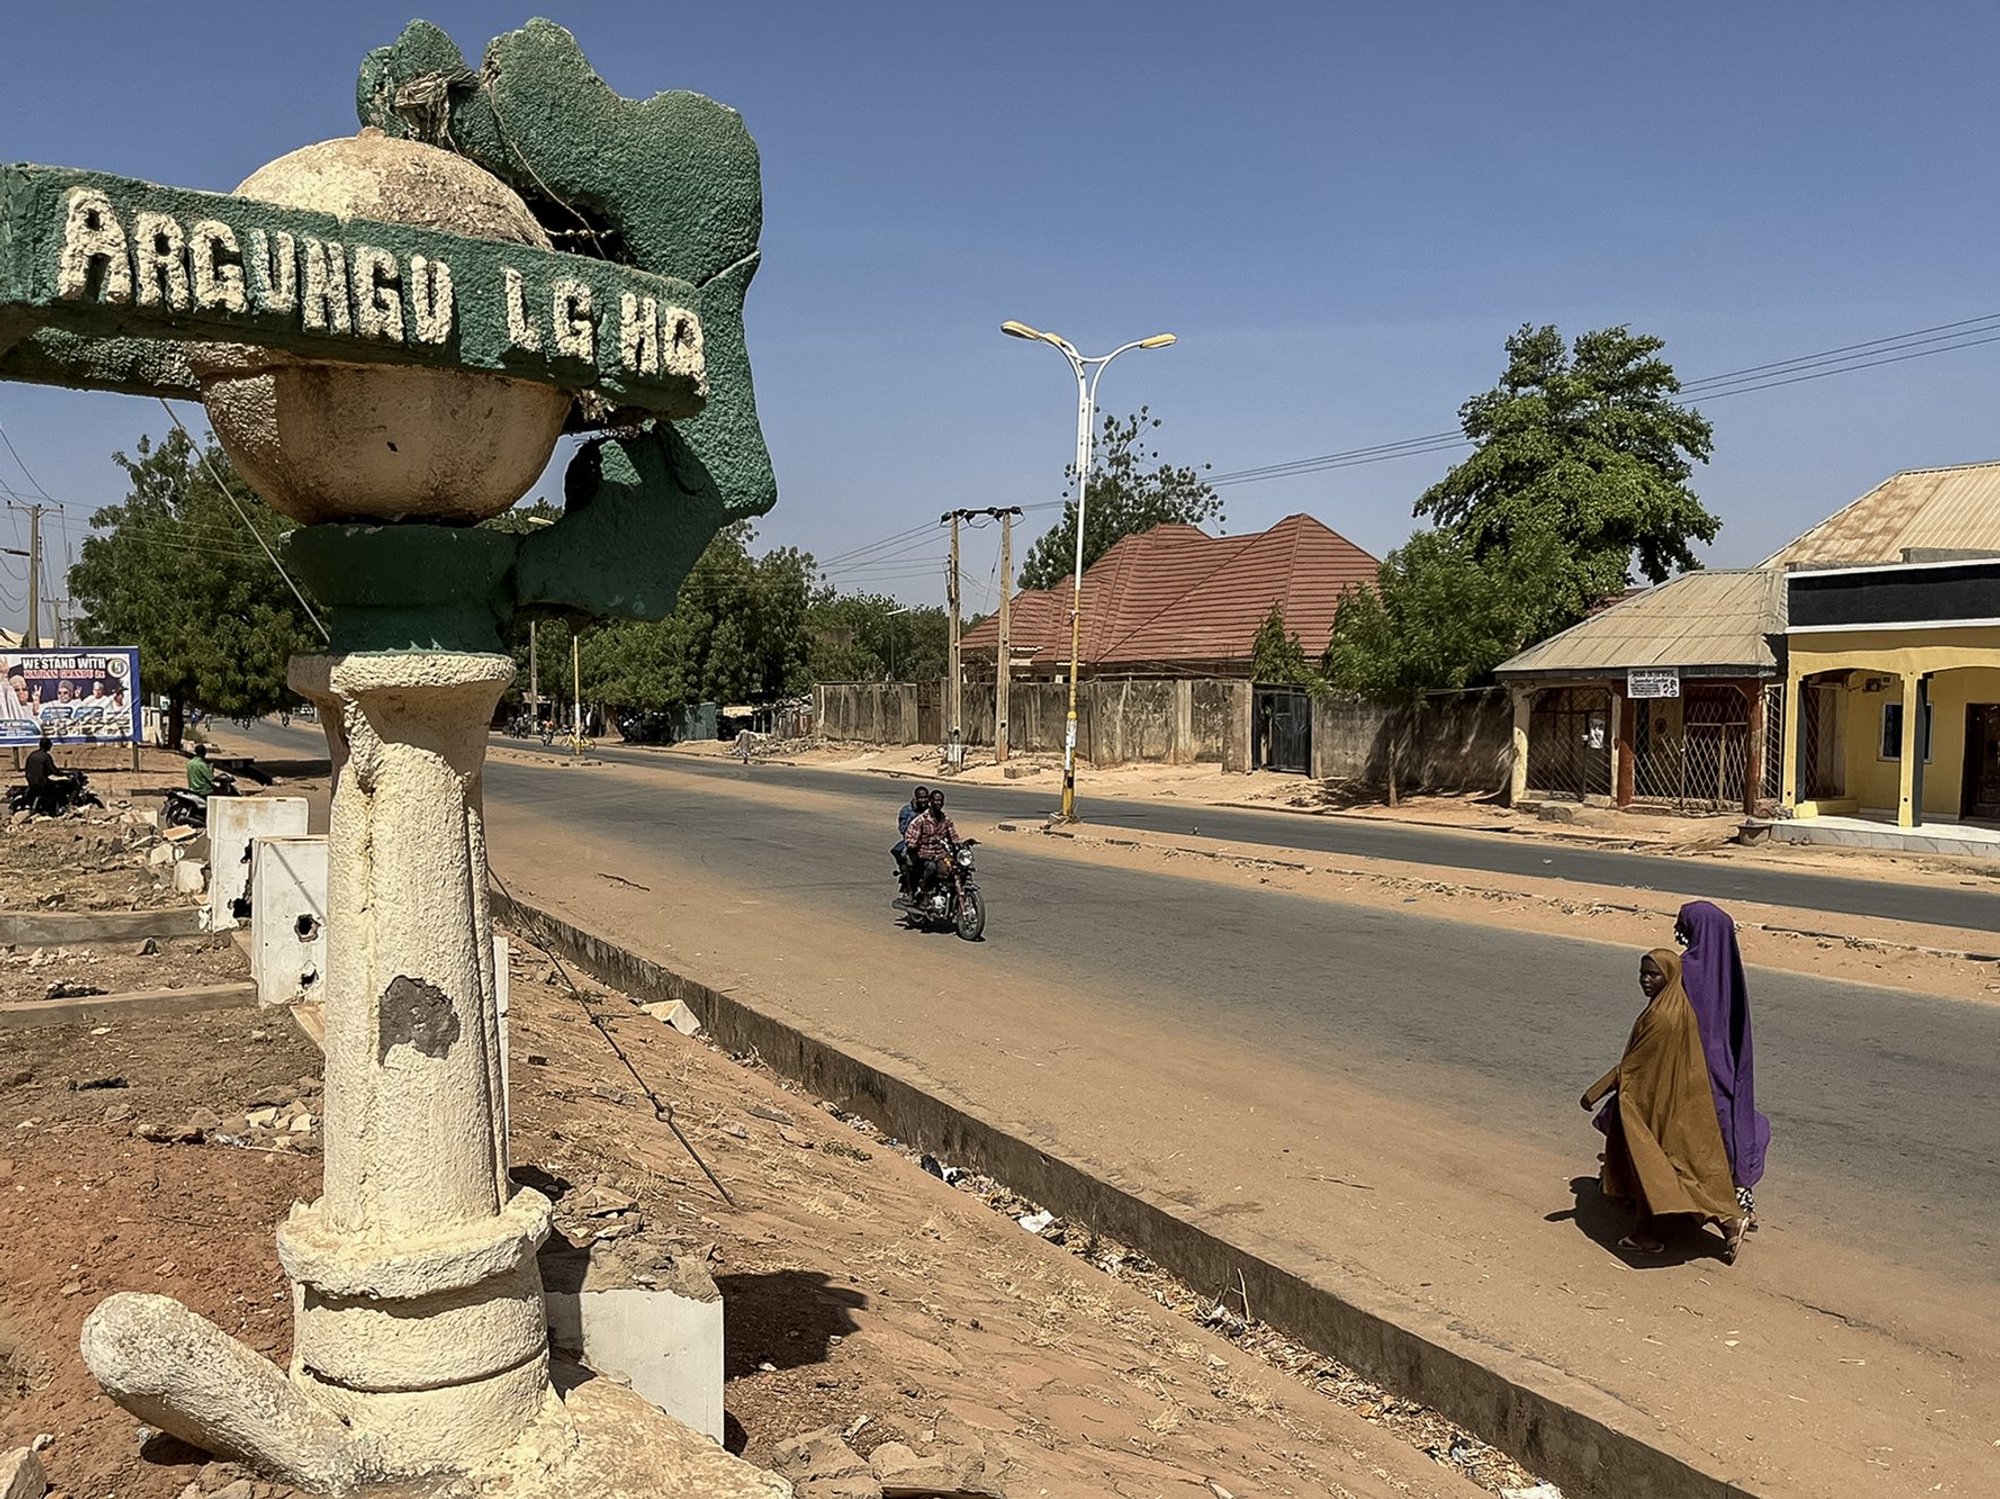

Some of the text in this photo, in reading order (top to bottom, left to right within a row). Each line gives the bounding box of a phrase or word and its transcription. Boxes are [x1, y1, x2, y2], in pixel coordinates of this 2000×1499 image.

[58, 187, 710, 396] ARGUNGU LG HQ
[22, 658, 106, 669] WE STAND WITH
